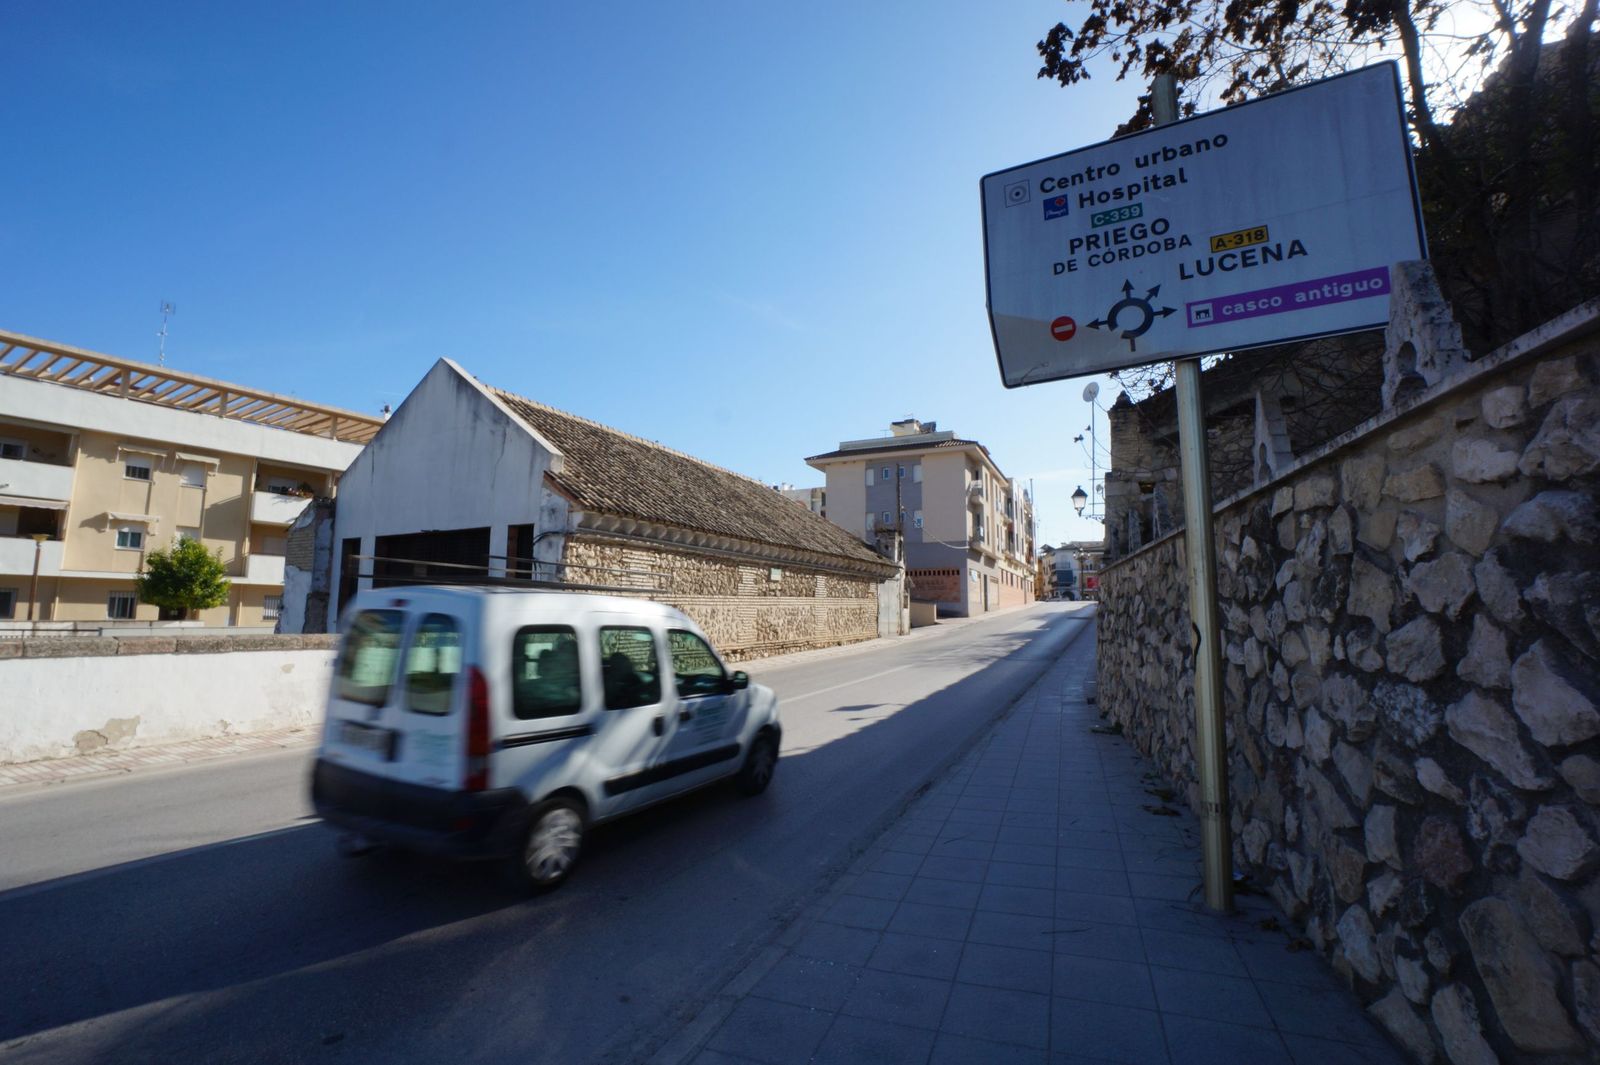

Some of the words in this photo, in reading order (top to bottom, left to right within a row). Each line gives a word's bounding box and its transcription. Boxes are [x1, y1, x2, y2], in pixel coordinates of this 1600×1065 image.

[1040, 161, 1120, 194] Centro
[1135, 133, 1228, 168] urbano
[1079, 168, 1187, 208] Hospital
[1069, 218, 1169, 254] PRIEGO
[1094, 206, 1141, 226] C-339
[1053, 259, 1078, 276] DE
[1088, 234, 1192, 267] CÓRDOBA
[1179, 239, 1308, 279] LUCENA
[1215, 229, 1265, 249] A-318
[1222, 295, 1282, 316] casco
[1295, 275, 1383, 304] antiguo
